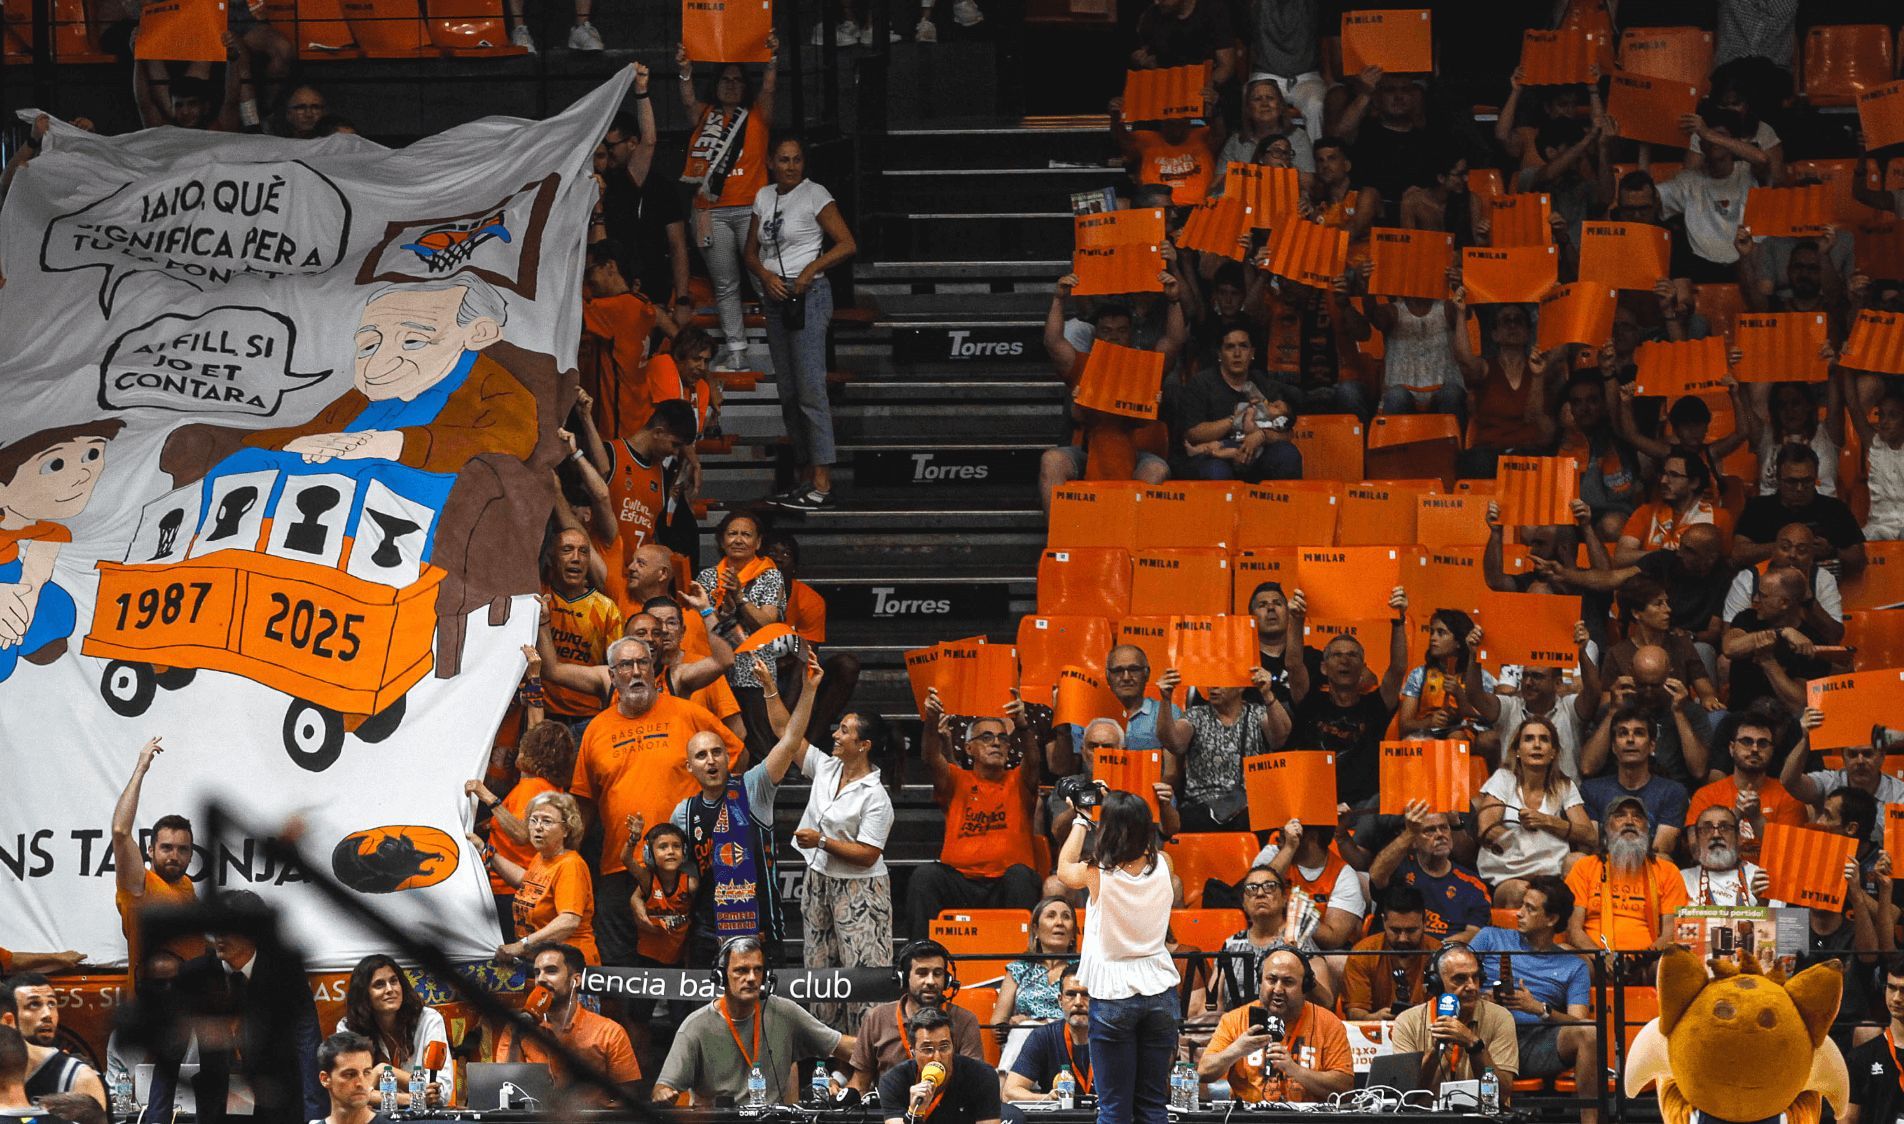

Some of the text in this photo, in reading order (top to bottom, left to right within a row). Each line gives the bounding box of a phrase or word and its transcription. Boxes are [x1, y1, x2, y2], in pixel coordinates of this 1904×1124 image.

[213, 175, 286, 217] QUÈ
[300, 247, 322, 267] A
[246, 335, 274, 358] SI
[949, 331, 1023, 356] Torres
[153, 355, 242, 381] JO ET
[115, 372, 267, 409] CONTARA
[911, 454, 988, 479] Torres
[634, 531, 646, 549] 7
[1314, 553, 1346, 563] MILAR
[872, 587, 950, 614] Torres
[114, 582, 365, 662] 1987 2025
[611, 722, 670, 740] BASQUET
[946, 926, 978, 936] MILAR
[581, 967, 665, 997] lencia
[790, 970, 852, 999] club
